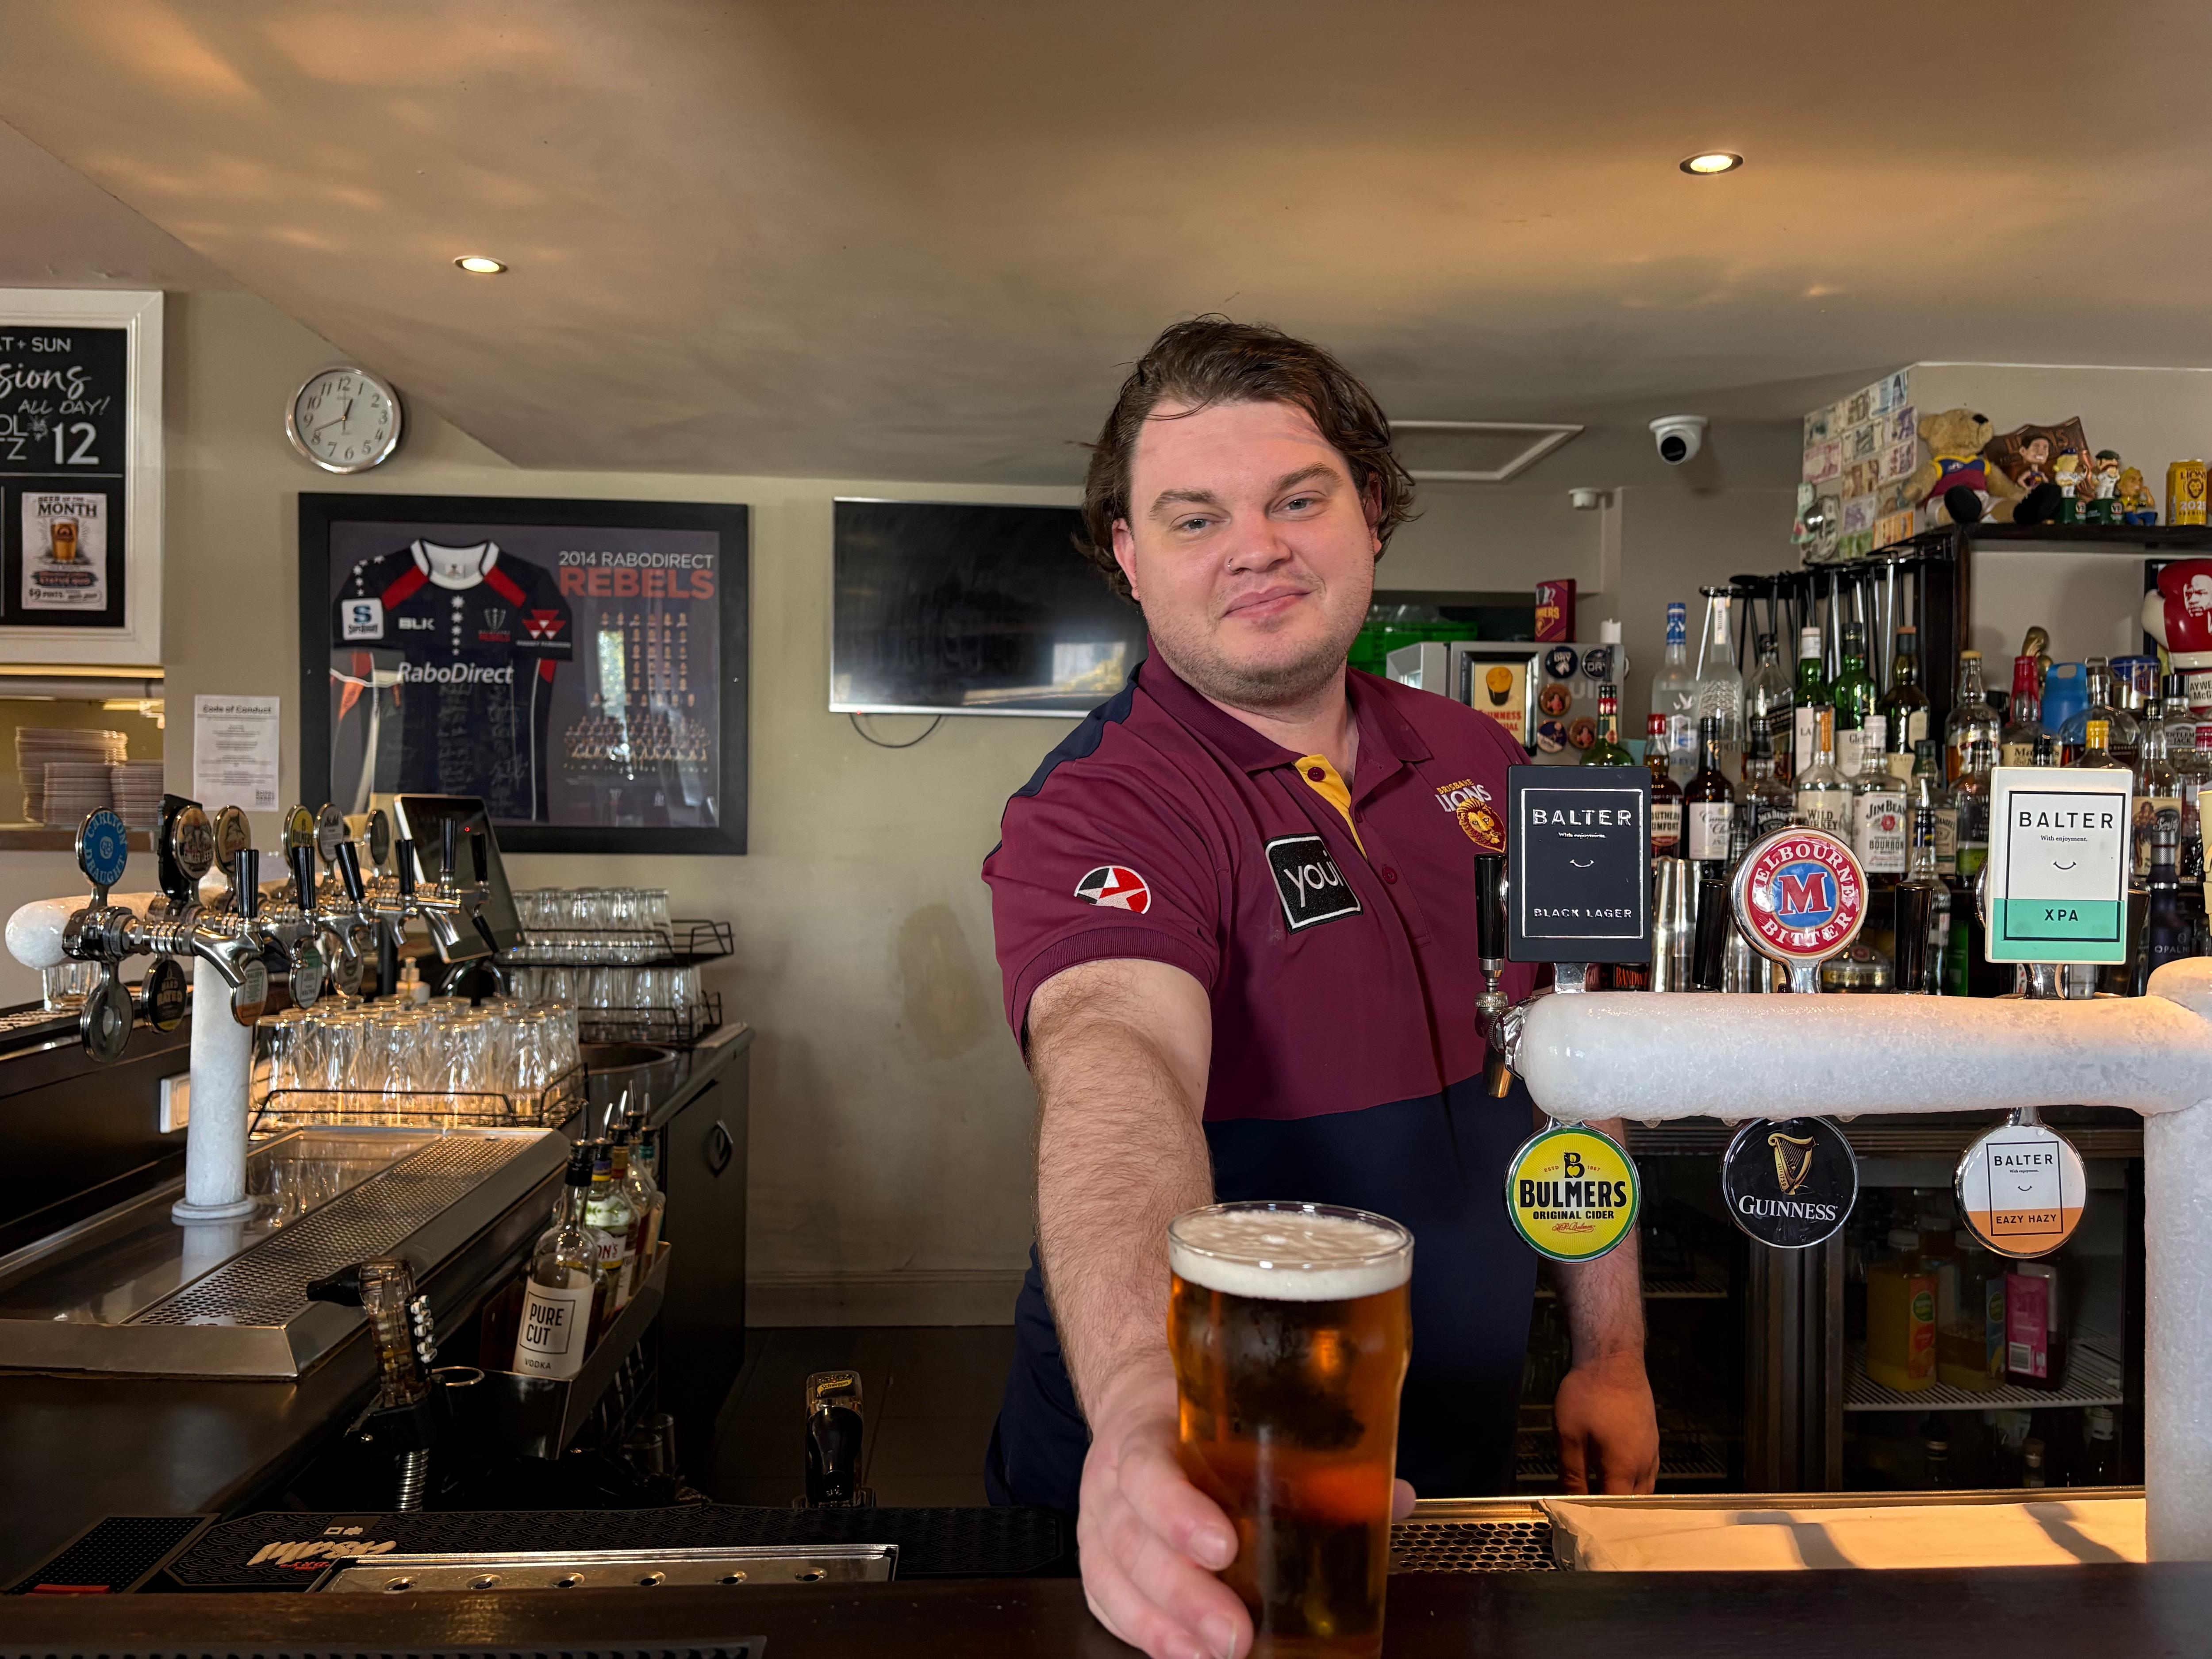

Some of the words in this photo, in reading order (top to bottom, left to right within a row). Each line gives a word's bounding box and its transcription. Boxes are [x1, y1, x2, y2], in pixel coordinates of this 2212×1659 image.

[0, 337, 15, 351] T
[31, 337, 72, 352] SUN
[321, 382, 332, 397] 11
[338, 376, 351, 391] 12
[358, 382, 364, 396] 1
[18, 399, 54, 415] ALL
[59, 396, 111, 416] DAY!
[307, 395, 322, 410] 10
[371, 393, 380, 408] 2
[304, 413, 313, 428] 9
[378, 409, 388, 425] 3
[375, 427, 383, 442] 4
[52, 422, 100, 465] 12
[327, 442, 338, 457] 7
[361, 440, 372, 455] 5
[345, 445, 354, 461] 6
[38, 503, 97, 517] MONTH
[558, 551, 596, 567] 2014
[602, 552, 714, 569] RABODIRECT
[559, 566, 715, 600] REBELS
[398, 617, 436, 631] BLK
[398, 661, 514, 684] RaboDirect
[1800, 727, 1812, 737] LA
[1436, 779, 1474, 795] BRISBANE
[1435, 784, 1492, 812] LIONS
[1533, 809, 1632, 826] BALTER
[1807, 809, 1833, 819] WILD
[1866, 803, 1885, 818] JIM
[88, 811, 127, 845] CARLTON
[1651, 822, 1679, 831] OMFORT
[1803, 819, 1838, 830] URKEY
[2019, 812, 2113, 829] BALTER
[84, 849, 125, 884] DRAUGHT
[1753, 843, 1855, 905] ELBOURNE
[1777, 872, 1832, 916] M
[1533, 908, 1578, 918] BLACK
[1586, 908, 1632, 918] LAGER
[2045, 909, 2078, 922] XPA
[1761, 912, 1853, 946] BITTER
[1564, 1152, 1585, 1178] B
[1994, 1154, 2053, 1166] BALTER
[1520, 1179, 1627, 1208] BULMERS
[1533, 1210, 1581, 1220] ORIGINAL
[1586, 1210, 1614, 1219] CIDER
[1739, 1195, 1836, 1221] GUINNESS
[1996, 1215, 2024, 1224] EAZY
[2028, 1214, 2057, 1223] HAZY
[530, 1303, 564, 1326] PURE
[526, 1324, 551, 1345] CUT
[525, 1358, 551, 1369] VODKA
[822, 1381, 849, 1390] Schweppes
